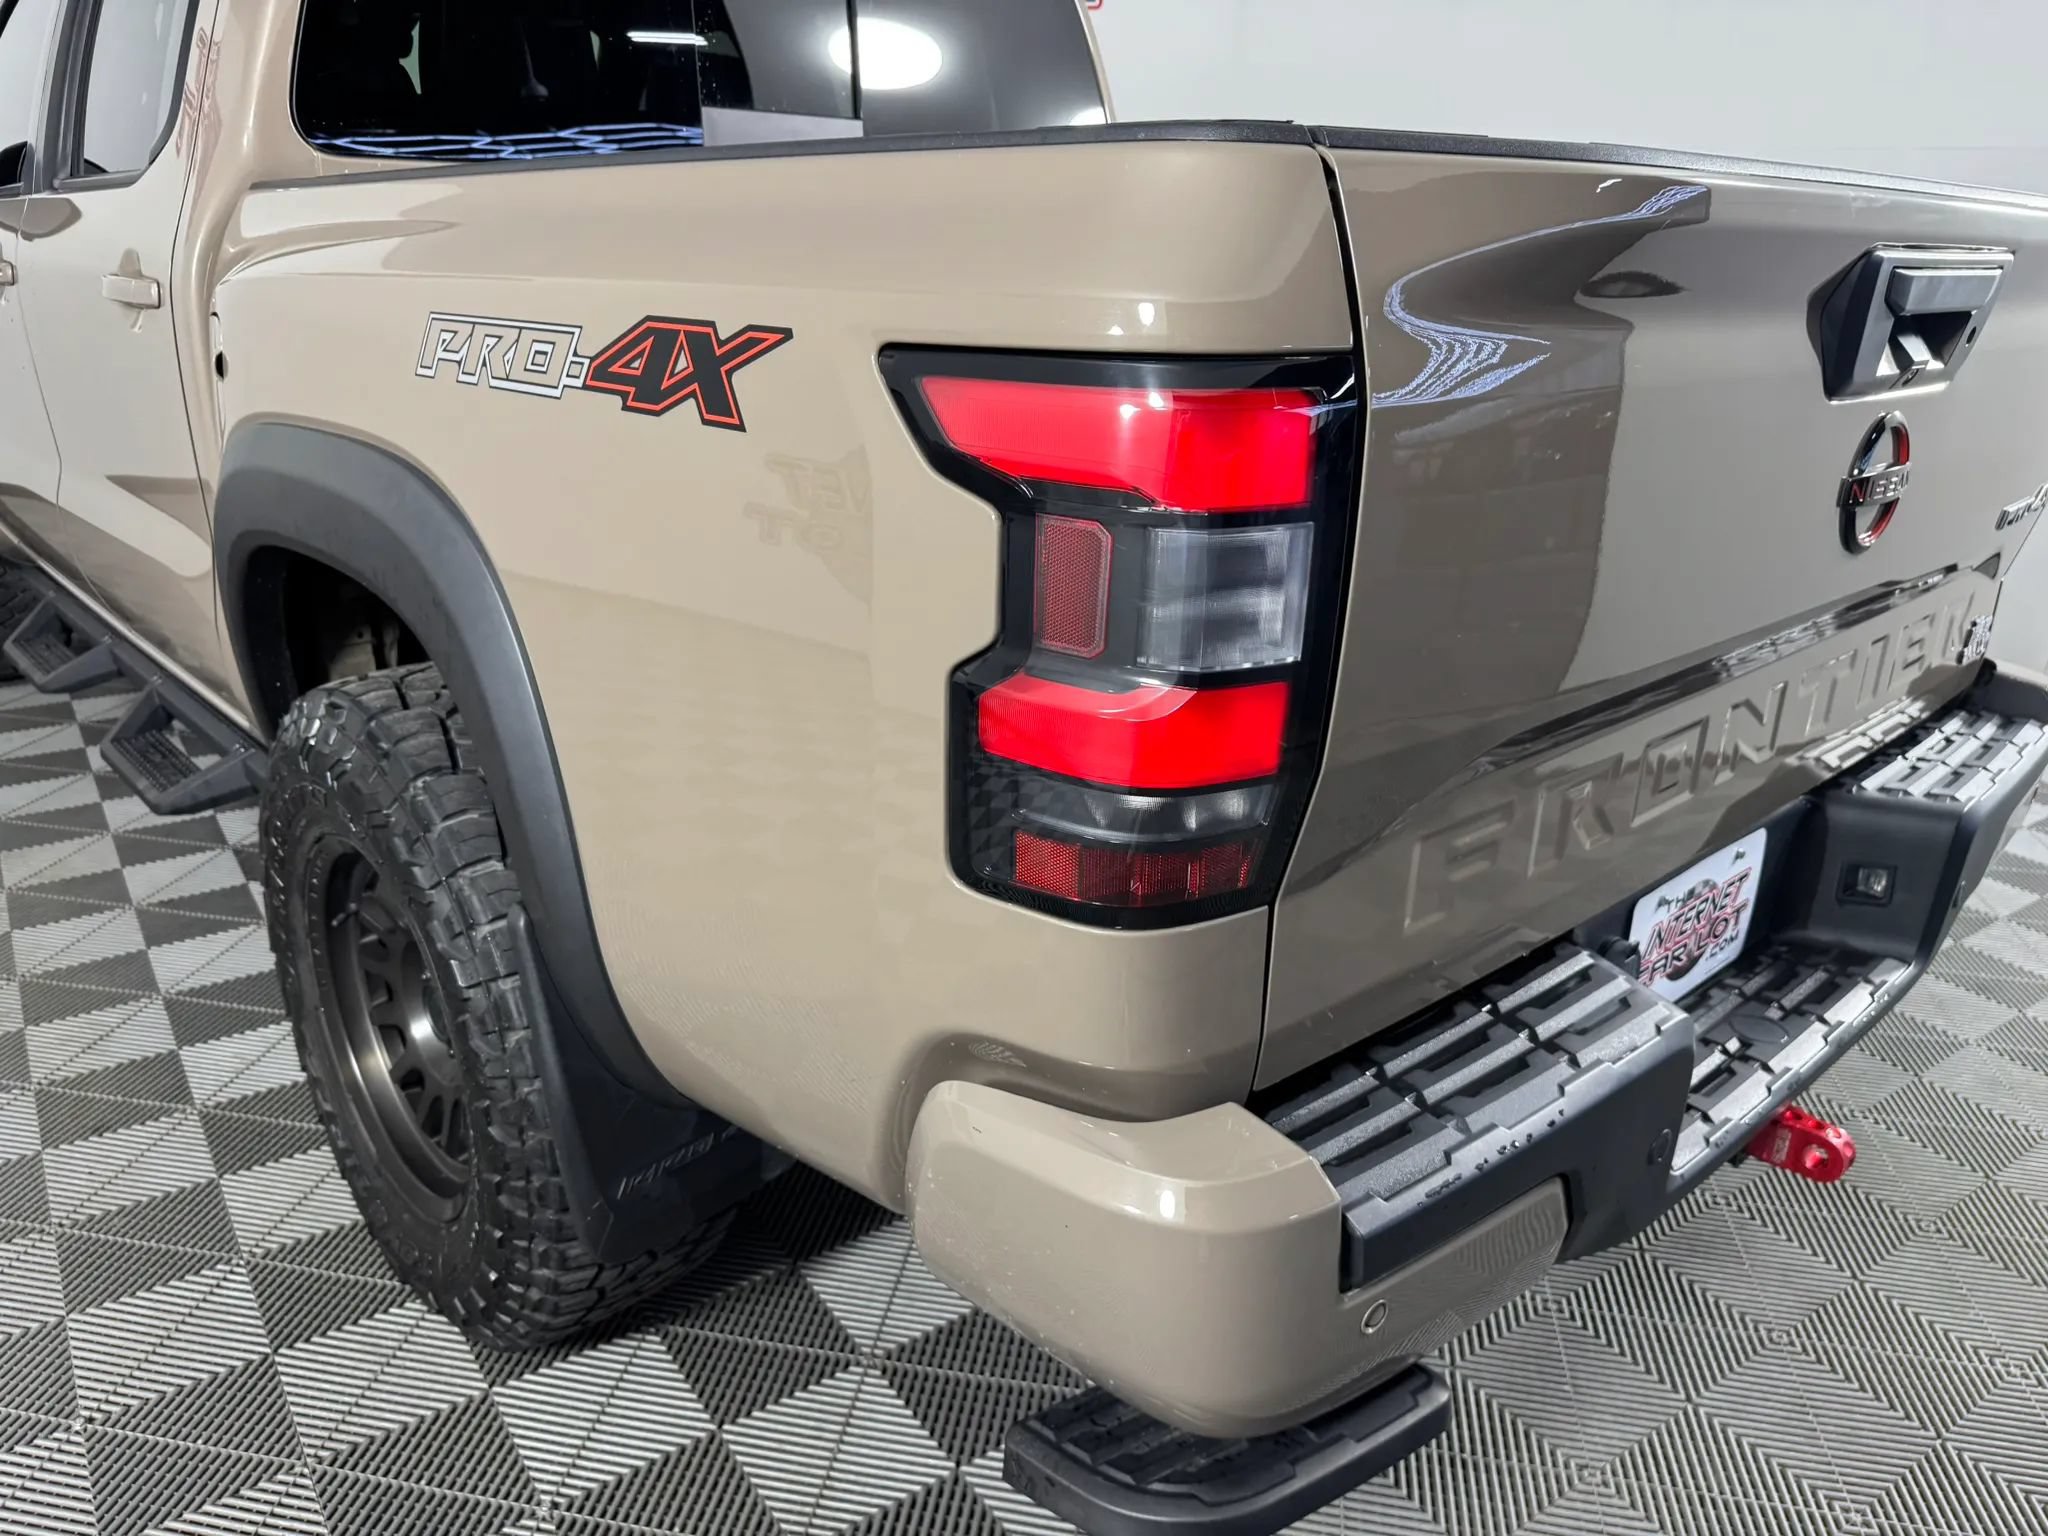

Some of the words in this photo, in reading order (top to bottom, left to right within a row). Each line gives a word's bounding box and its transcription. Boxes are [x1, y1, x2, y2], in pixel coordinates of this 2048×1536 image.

[1848, 467, 1911, 504] NISSAN
[1404, 590, 1976, 929] FRONTIER
[1643, 867, 1752, 959] INTERNET
[1693, 899, 1749, 956] LOT
